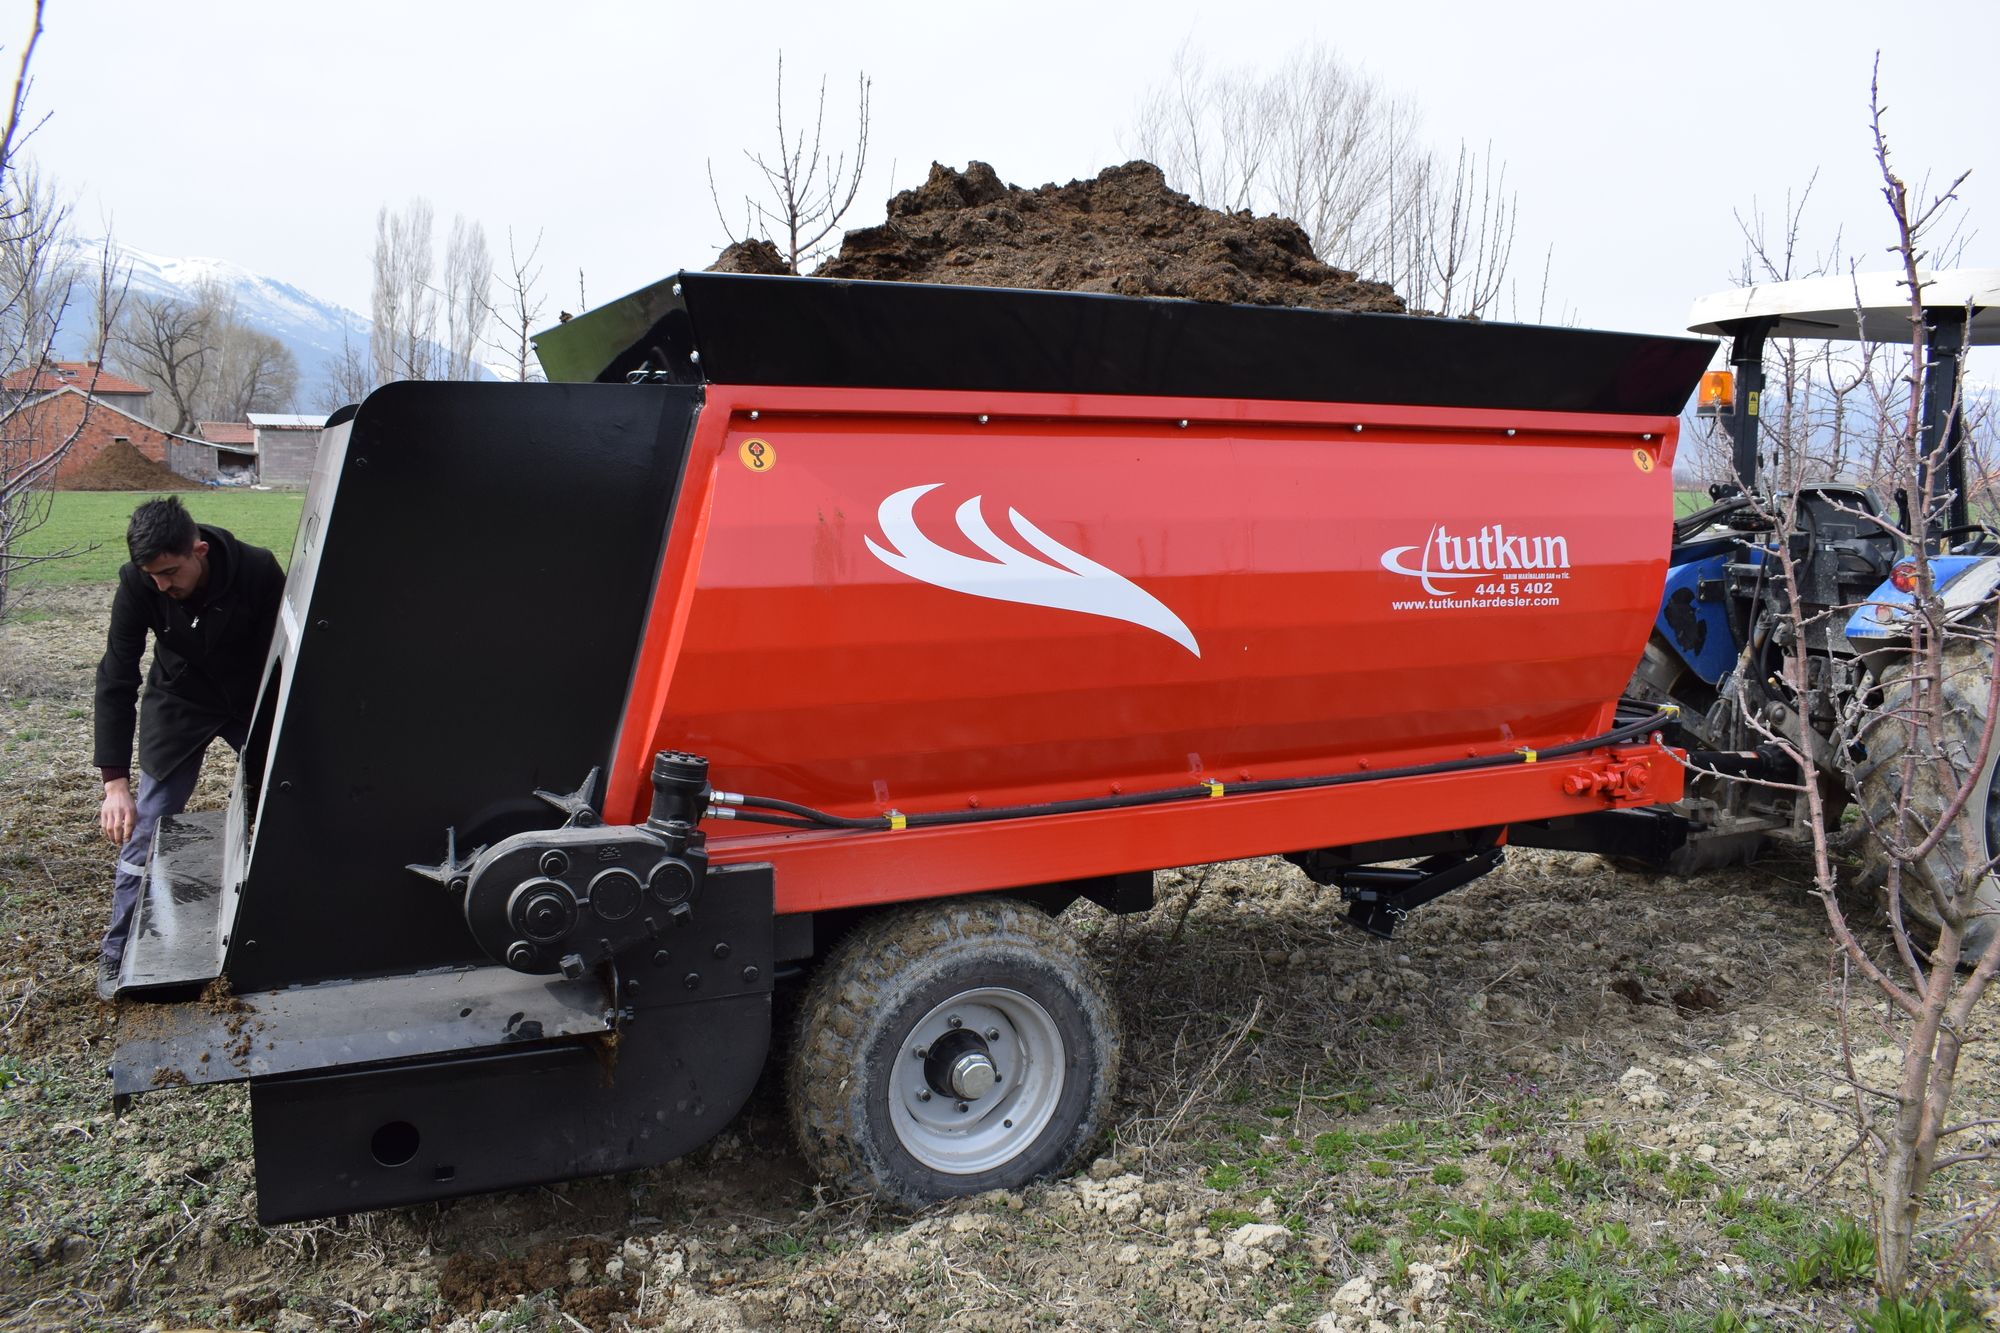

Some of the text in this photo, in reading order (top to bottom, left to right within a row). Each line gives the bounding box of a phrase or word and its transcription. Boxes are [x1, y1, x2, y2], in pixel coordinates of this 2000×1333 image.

[1435, 523, 1571, 570] tutkun
[1475, 582, 1553, 595] 444 5 402
[1392, 595, 1560, 611] www.tutkunkardesler.com
